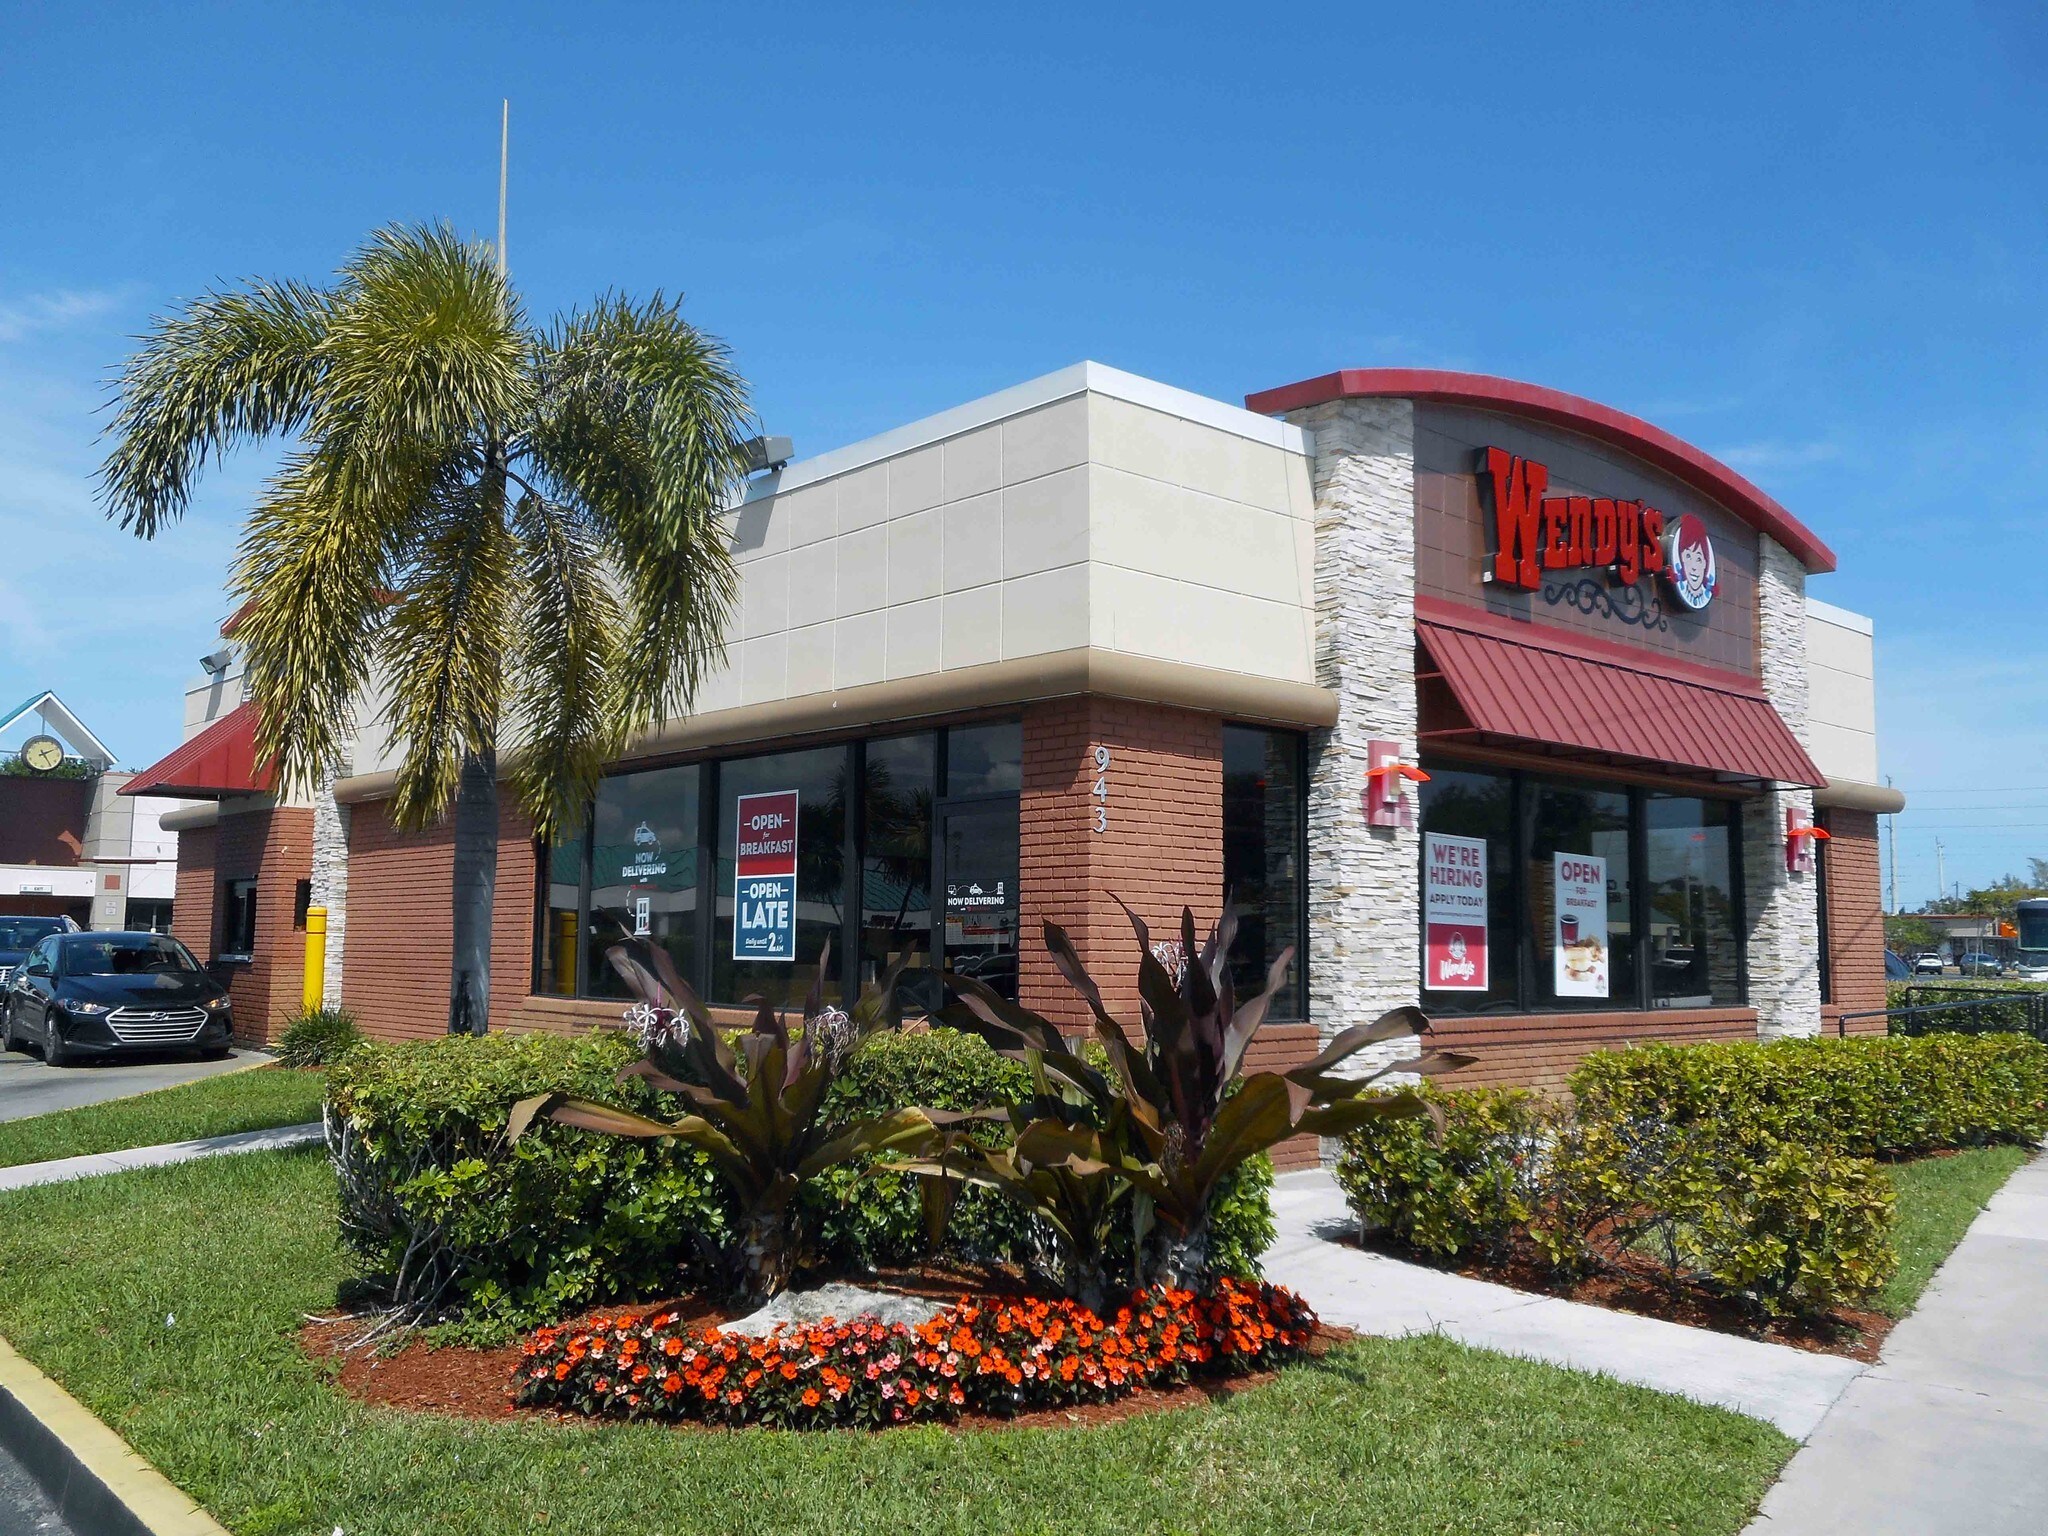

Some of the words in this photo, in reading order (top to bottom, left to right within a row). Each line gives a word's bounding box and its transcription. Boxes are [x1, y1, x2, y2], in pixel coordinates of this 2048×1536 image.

[751, 813, 783, 831] OPEN
[762, 831, 771, 840] for
[740, 839, 794, 856] BREAKFAST
[1432, 843, 1480, 868] WE'RE
[635, 851, 654, 864] NOW
[622, 863, 667, 878] DELIVERING
[1431, 867, 1482, 888] HIRING
[1561, 861, 1601, 885] OPEN
[749, 882, 782, 899] OPEN
[1575, 887, 1587, 895] FOR
[947, 898, 964, 906] NOW
[964, 897, 1005, 905] DELIVERING
[1429, 893, 1456, 906] APPLY
[1457, 895, 1484, 908] TODAY
[1566, 898, 1597, 908] BREAKFAST
[742, 902, 788, 929] LATE
[1440, 959, 1475, 981] Wendy's
